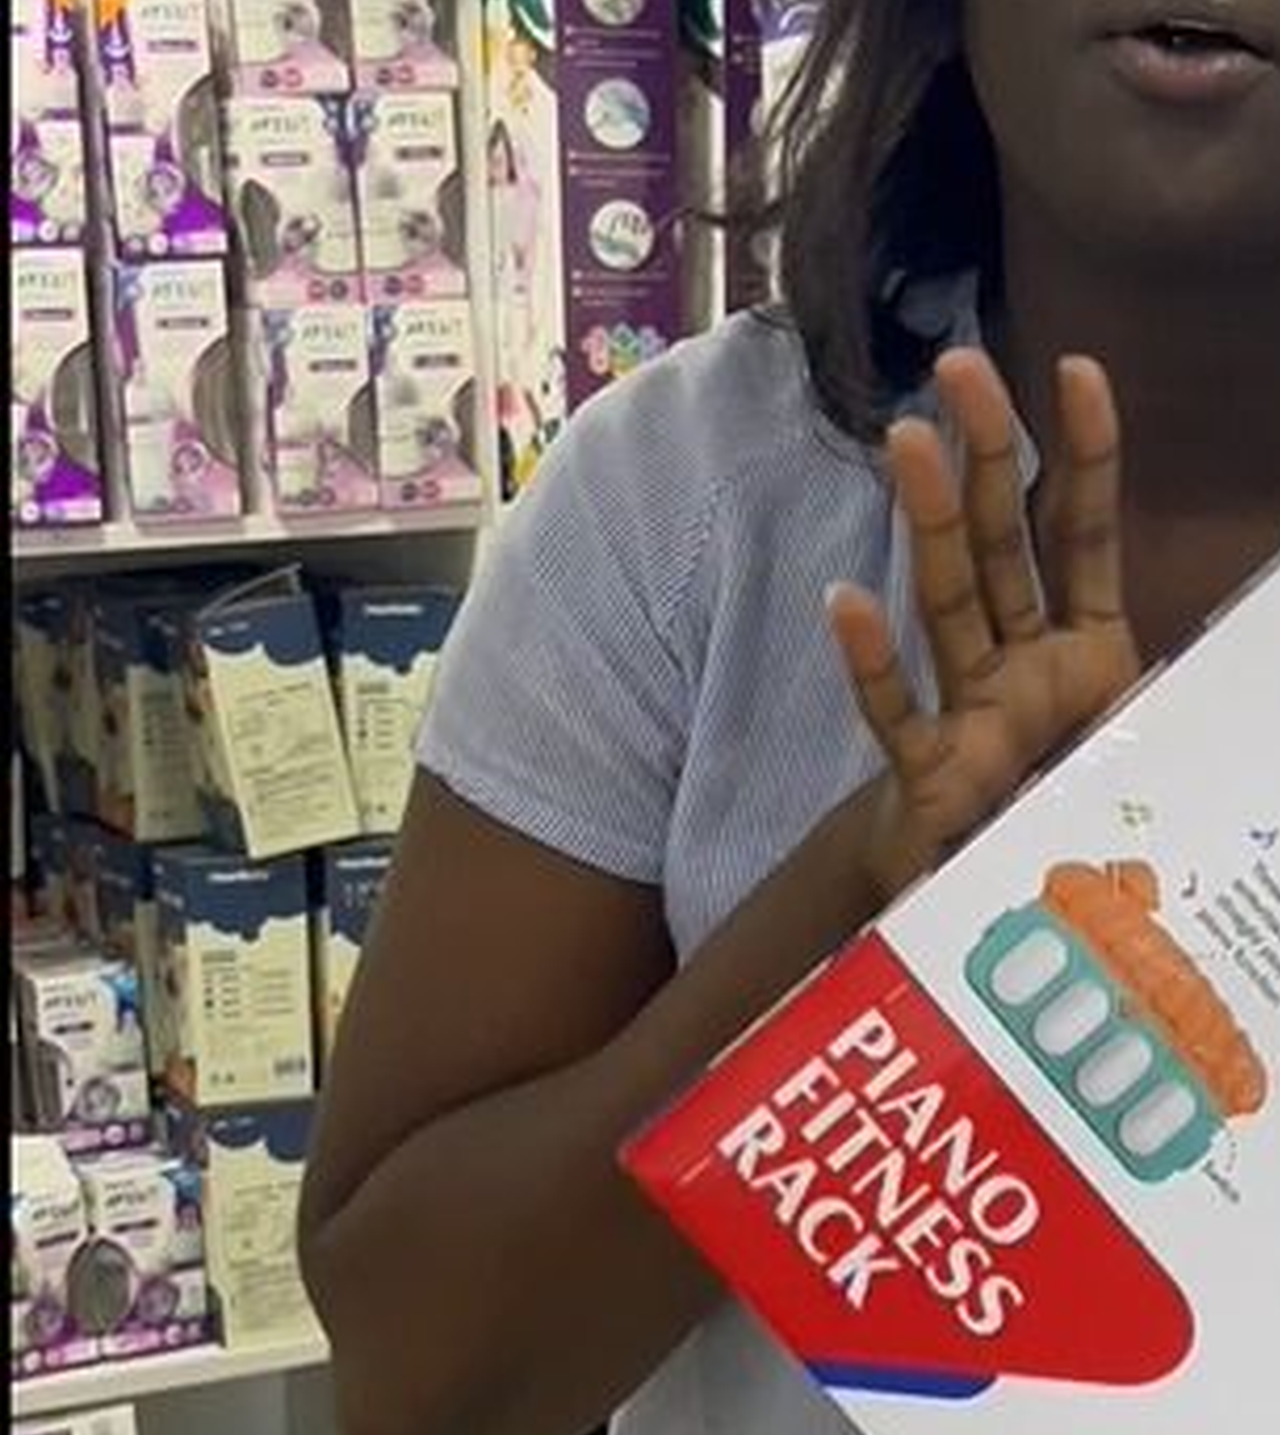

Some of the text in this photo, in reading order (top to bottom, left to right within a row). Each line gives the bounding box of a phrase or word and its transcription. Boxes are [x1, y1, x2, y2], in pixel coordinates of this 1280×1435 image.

[716, 1103, 900, 1310] RACK
[771, 1056, 1025, 1336] FITNESS
[827, 1008, 1040, 1245] PIANO
